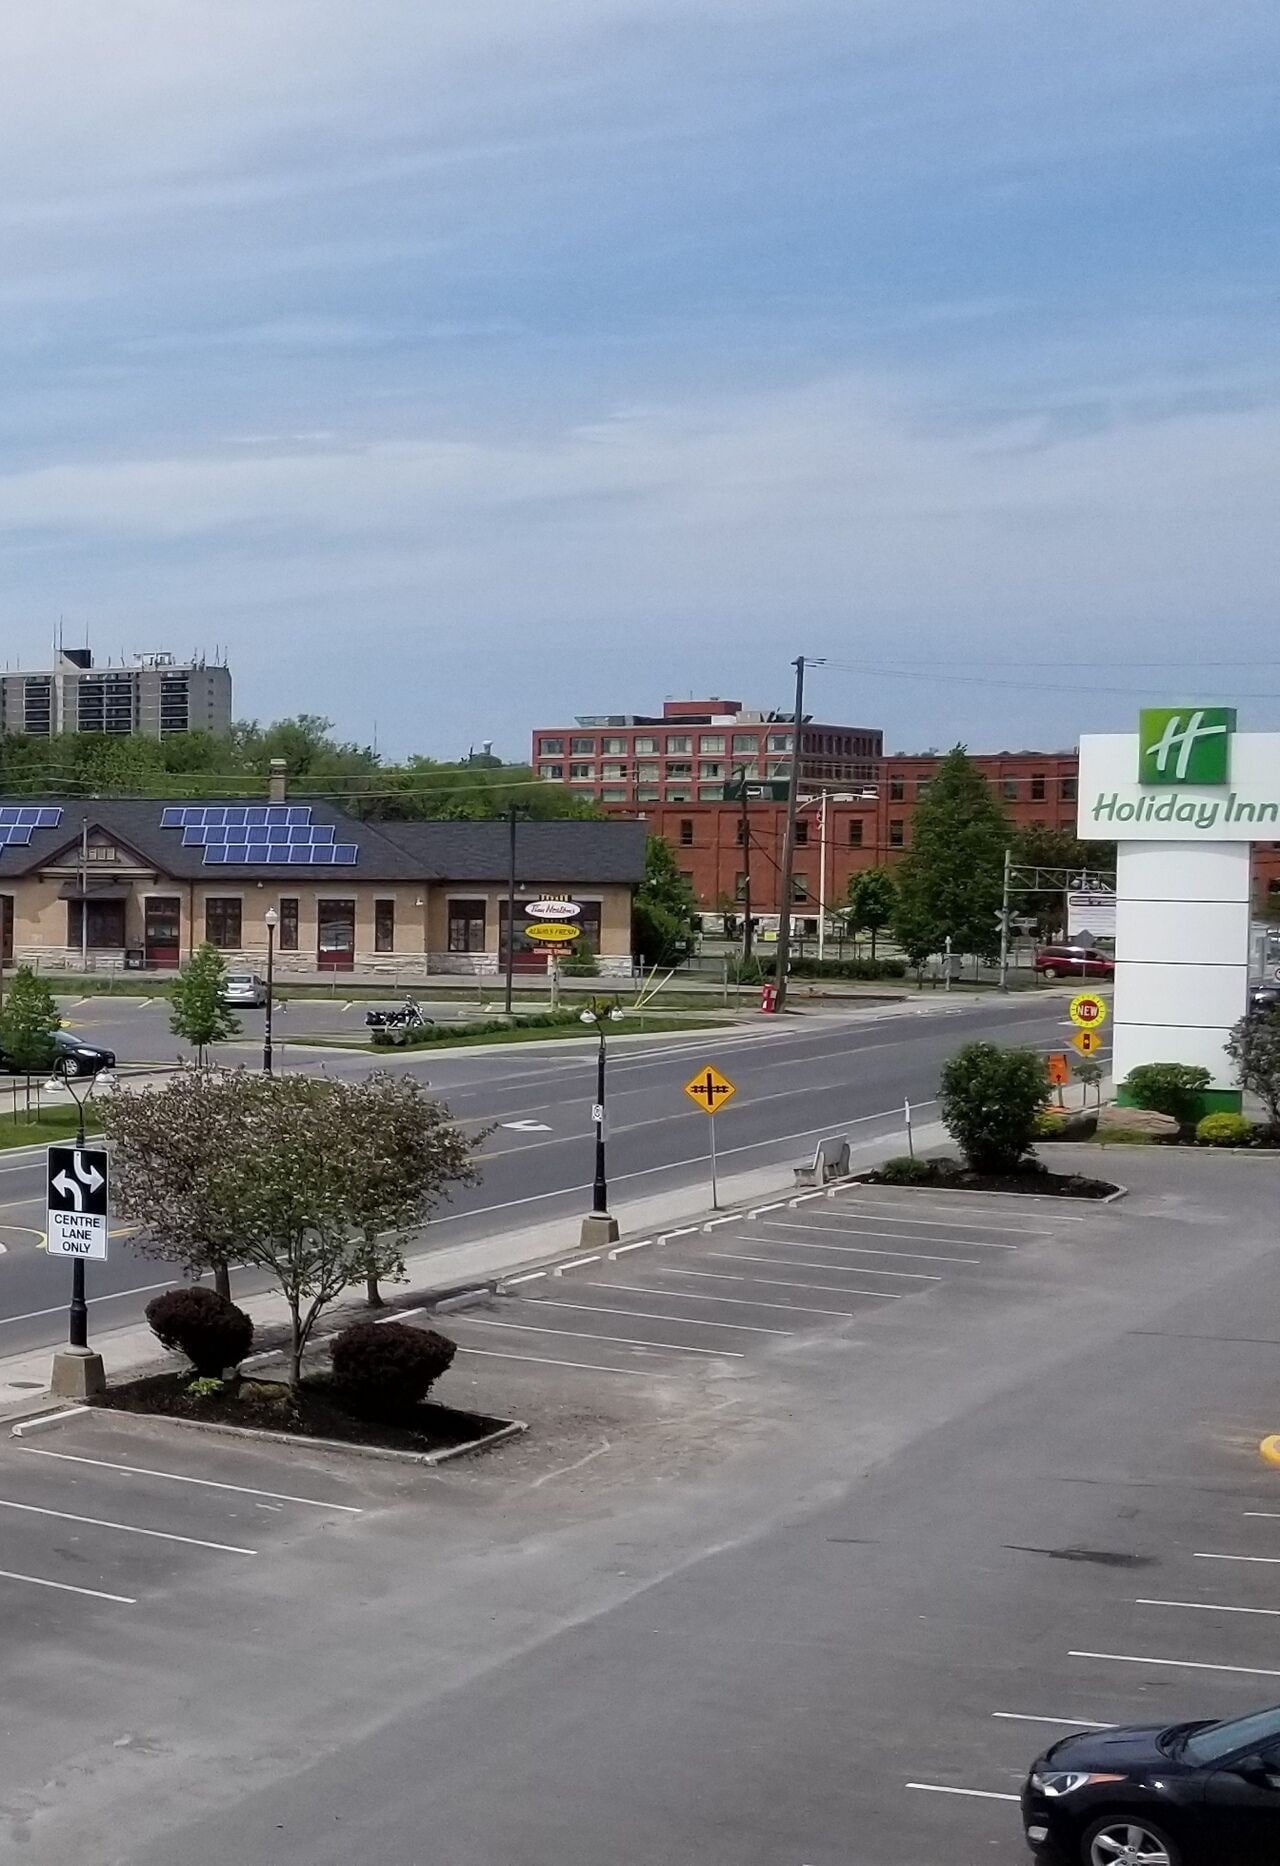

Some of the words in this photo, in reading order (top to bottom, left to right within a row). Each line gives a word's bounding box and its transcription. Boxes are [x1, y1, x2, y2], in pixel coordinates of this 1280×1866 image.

[1091, 792, 1220, 829] Holiday
[1224, 792, 1279, 823] Inn
[1077, 1005, 1099, 1017] NEW
[54, 1213, 101, 1228] CENTRE
[61, 1227, 92, 1241] LANE
[62, 1241, 91, 1254] ONLY
